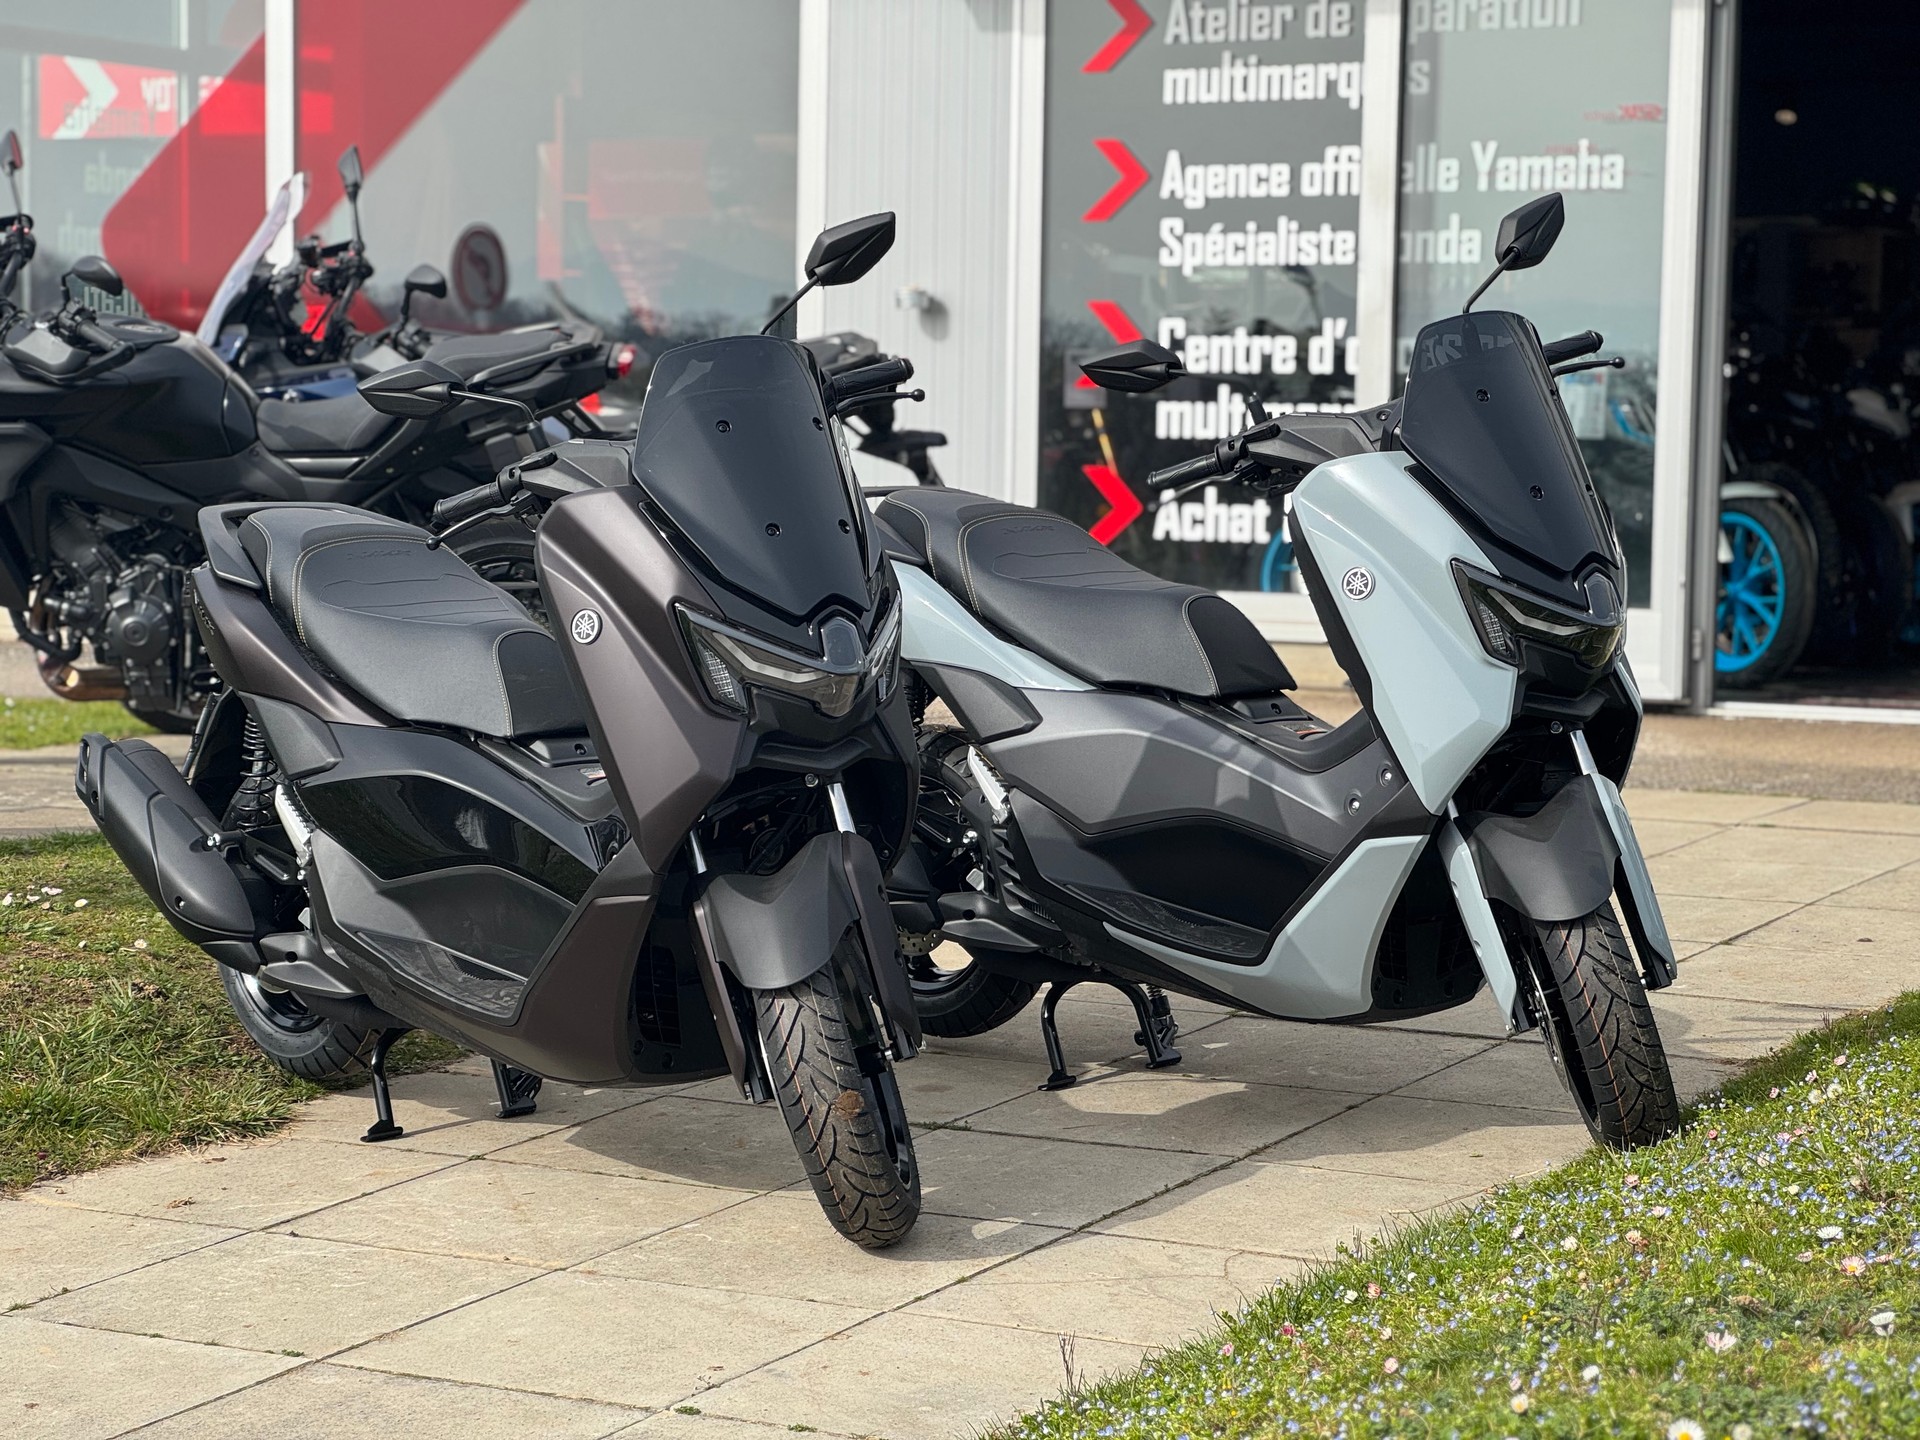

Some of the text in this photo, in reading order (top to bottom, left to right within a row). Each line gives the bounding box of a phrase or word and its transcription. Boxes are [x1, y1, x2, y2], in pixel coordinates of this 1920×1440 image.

[1163, 0, 1294, 44] Atelier
[1305, 0, 1352, 39] de
[1159, 138, 1625, 209] Agence offielle Yamaha
[1158, 213, 1482, 278] Spécialiste onda
[1158, 317, 1297, 375] Centre
[1152, 485, 1271, 544] Achat
